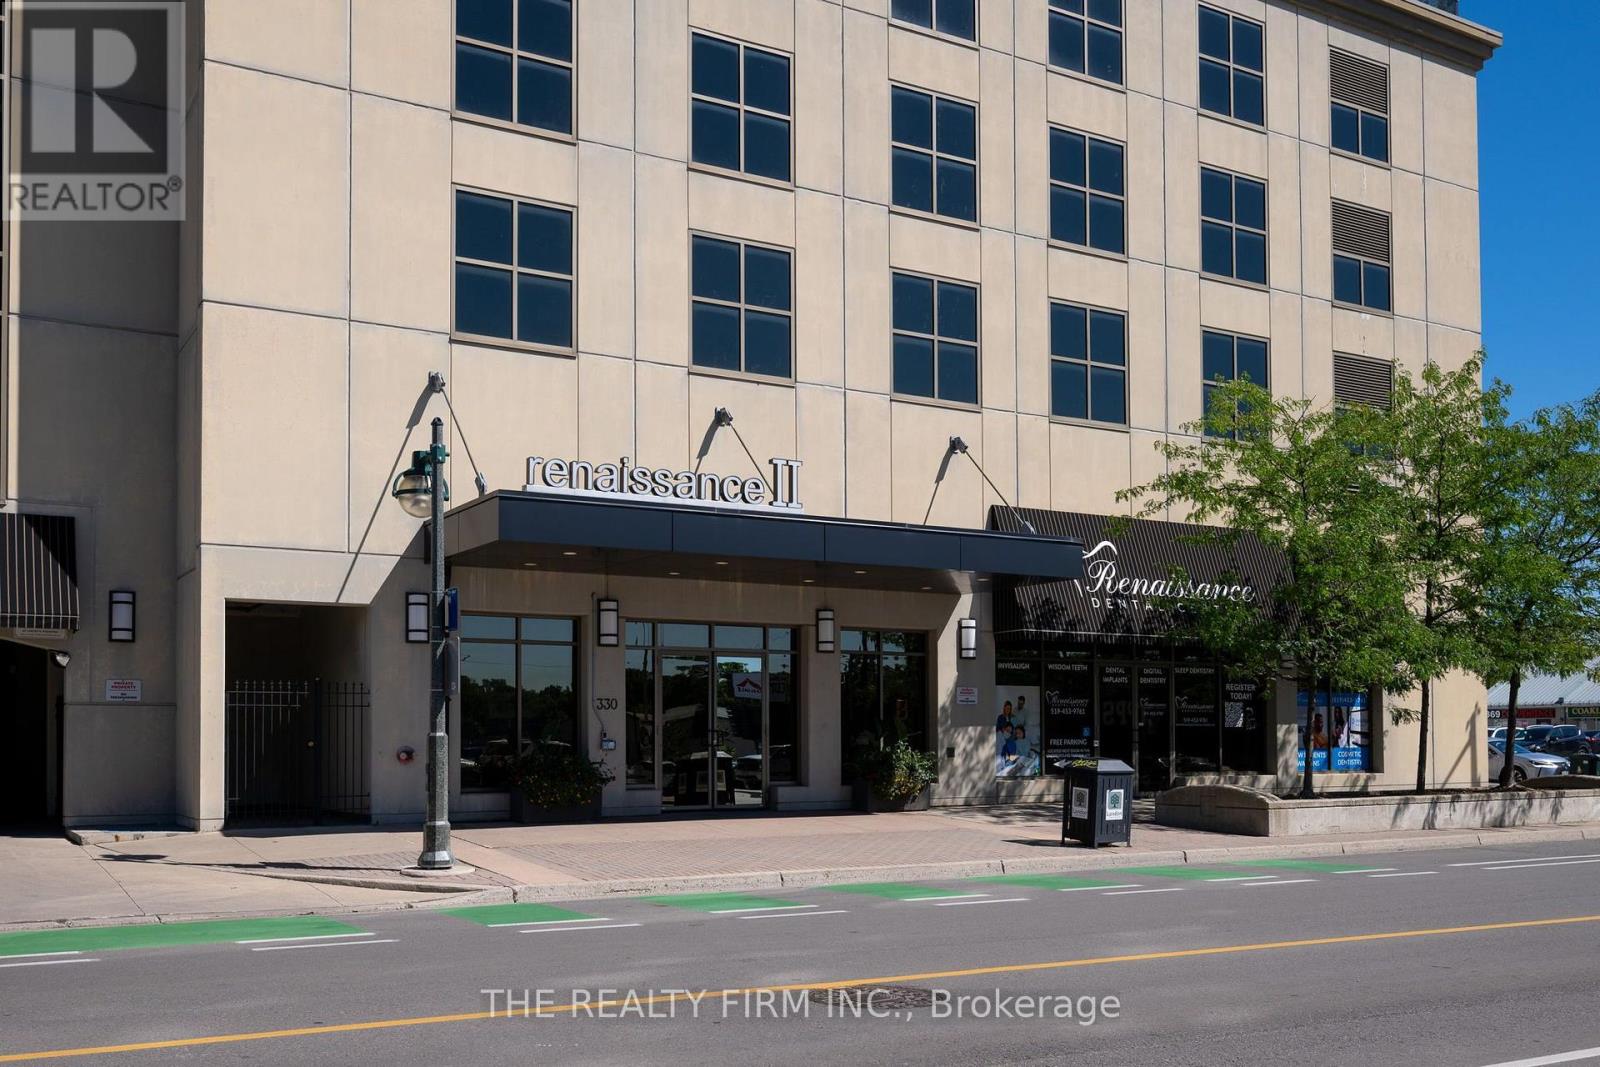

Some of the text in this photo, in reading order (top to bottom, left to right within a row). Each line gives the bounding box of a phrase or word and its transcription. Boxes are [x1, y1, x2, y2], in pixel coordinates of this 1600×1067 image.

[526, 455, 803, 508] renaissance II
[1086, 559, 1255, 602] Renaissance
[997, 662, 1031, 670] INVISALIGN
[1047, 663, 1071, 671] WISDOM
[1105, 666, 1125, 674] DENTAL
[1143, 667, 1163, 675] DIGITAL
[1102, 676, 1128, 684] IMPLANTS
[1225, 683, 1256, 691] REGISTER
[596, 698, 618, 710] 330
[1049, 738, 1088, 746] FREE PARKING
